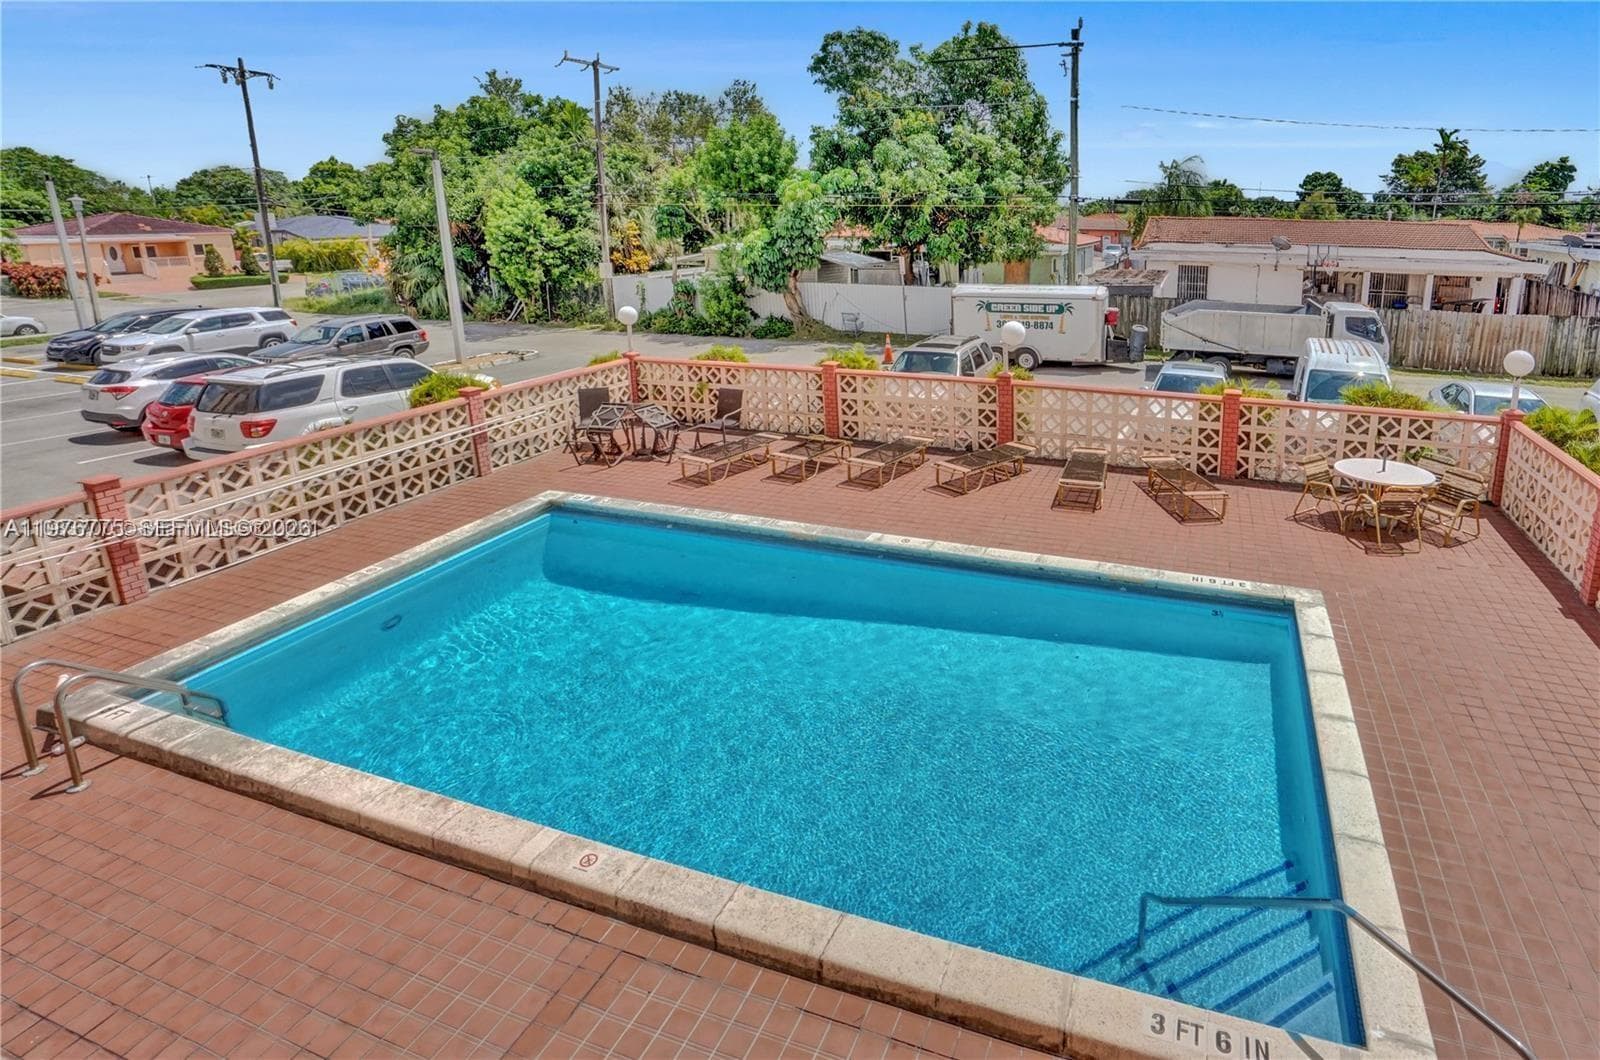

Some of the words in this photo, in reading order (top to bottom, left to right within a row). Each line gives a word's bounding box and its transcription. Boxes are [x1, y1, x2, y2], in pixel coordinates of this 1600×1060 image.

[1023, 304, 1045, 312] SIDE
[1150, 1013, 1166, 1035] 3
[1176, 1018, 1204, 1047] FT
[1215, 1030, 1232, 1054] 6
[1245, 1036, 1270, 1060] IN
